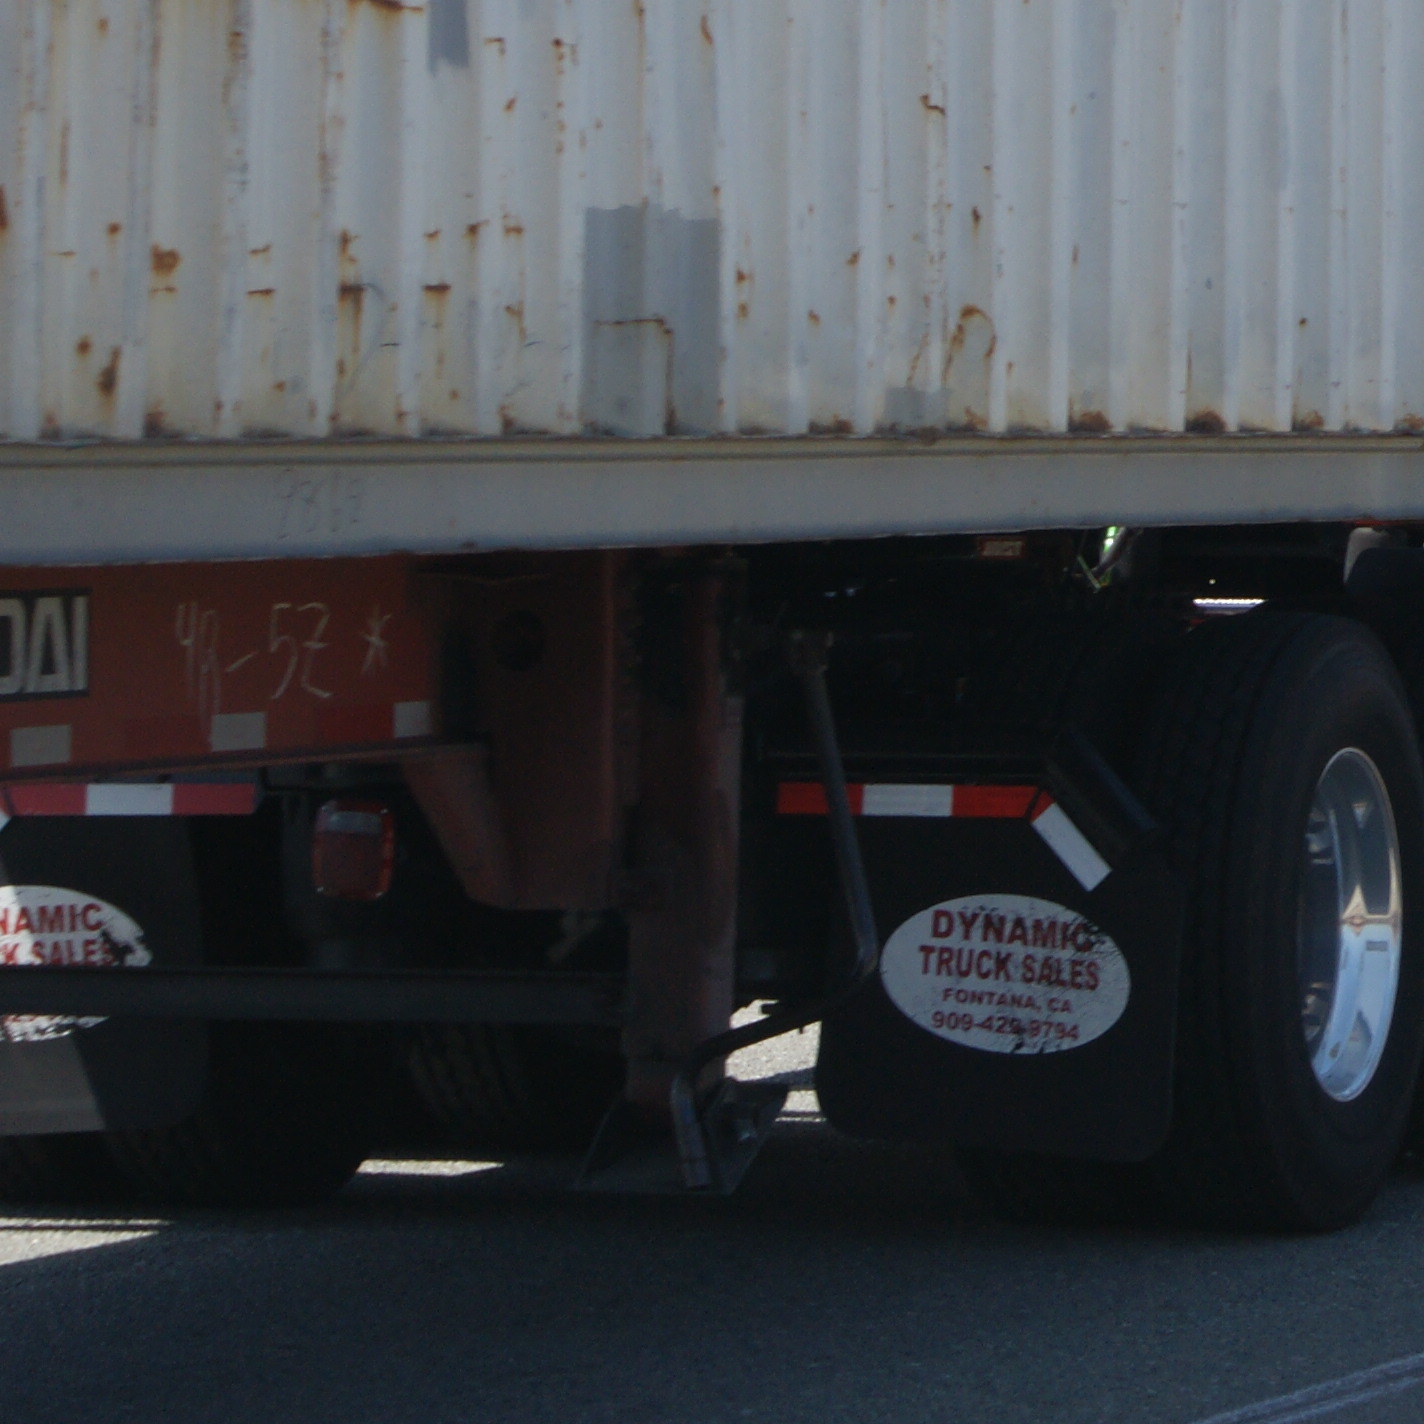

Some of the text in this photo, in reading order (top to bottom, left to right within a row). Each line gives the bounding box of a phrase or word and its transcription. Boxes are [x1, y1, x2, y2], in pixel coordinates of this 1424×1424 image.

[932, 909, 1094, 952] DYNAMIC
[920, 945, 1099, 990] TRUCK SALES
[1047, 997, 1073, 1014] CA
